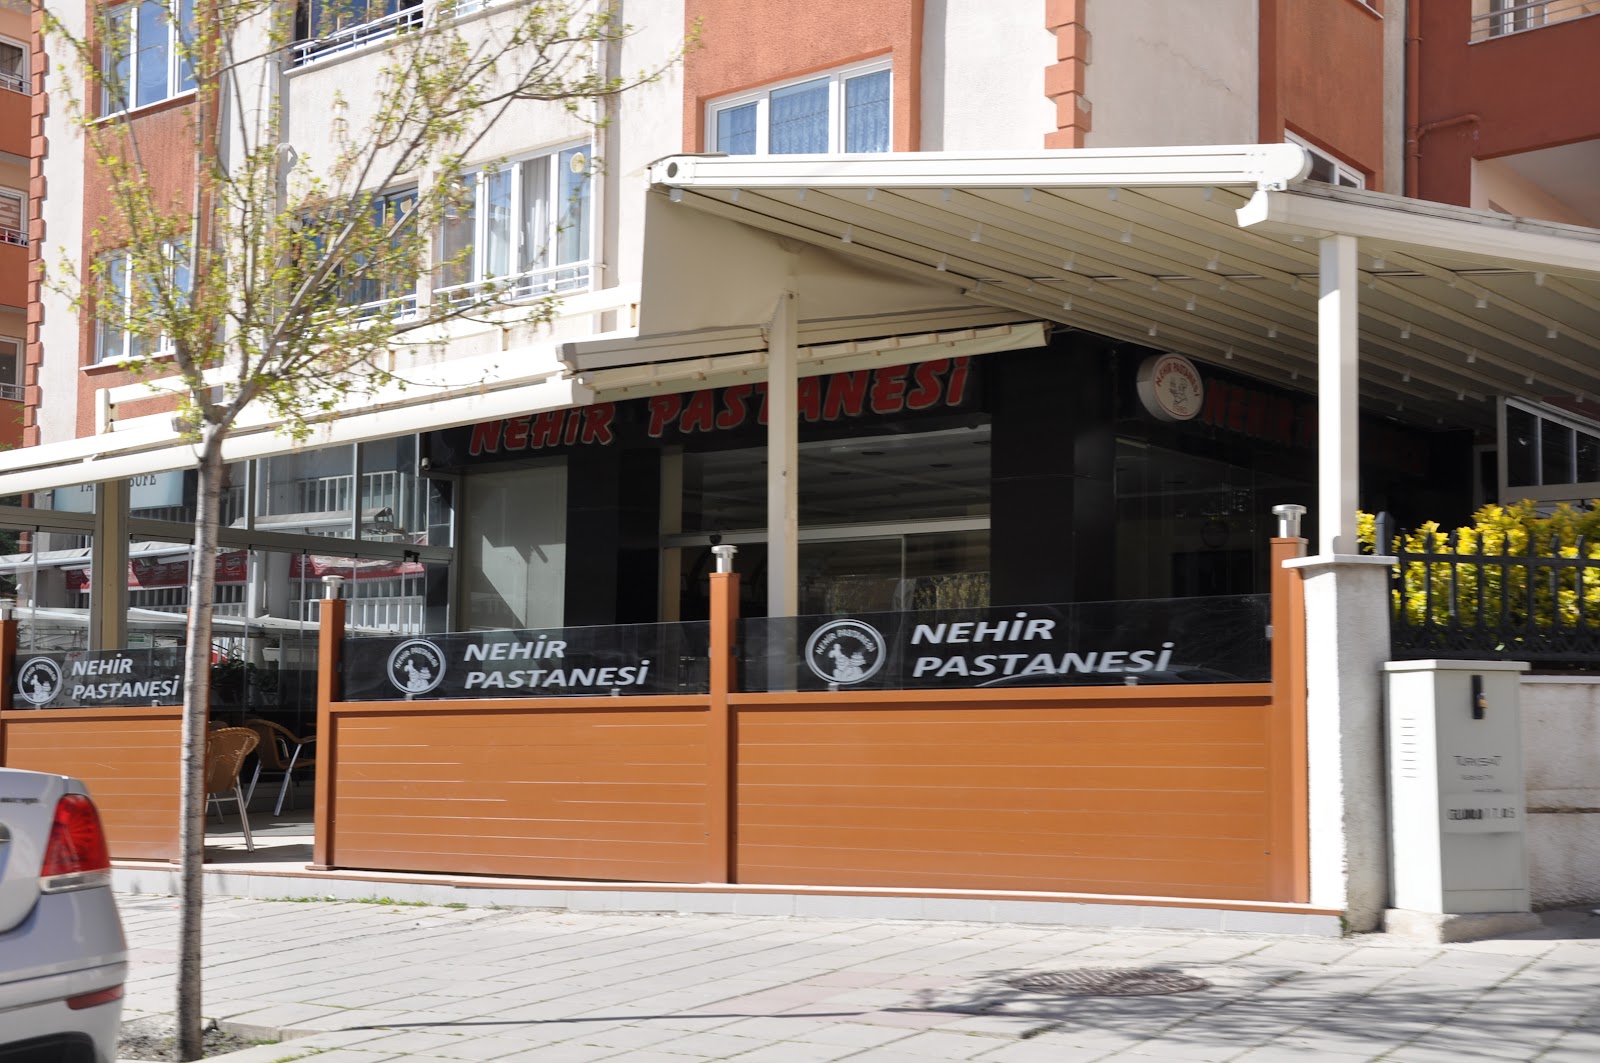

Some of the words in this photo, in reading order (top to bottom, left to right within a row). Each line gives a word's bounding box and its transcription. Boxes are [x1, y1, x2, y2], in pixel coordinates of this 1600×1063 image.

[911, 612, 1055, 646] NEHİR
[463, 634, 567, 662] NEHİR
[913, 641, 1175, 679] PASTANESİ
[72, 653, 133, 676] NEHİR
[464, 659, 650, 690] PASTANESİ
[71, 674, 180, 700] PASTANESİ
